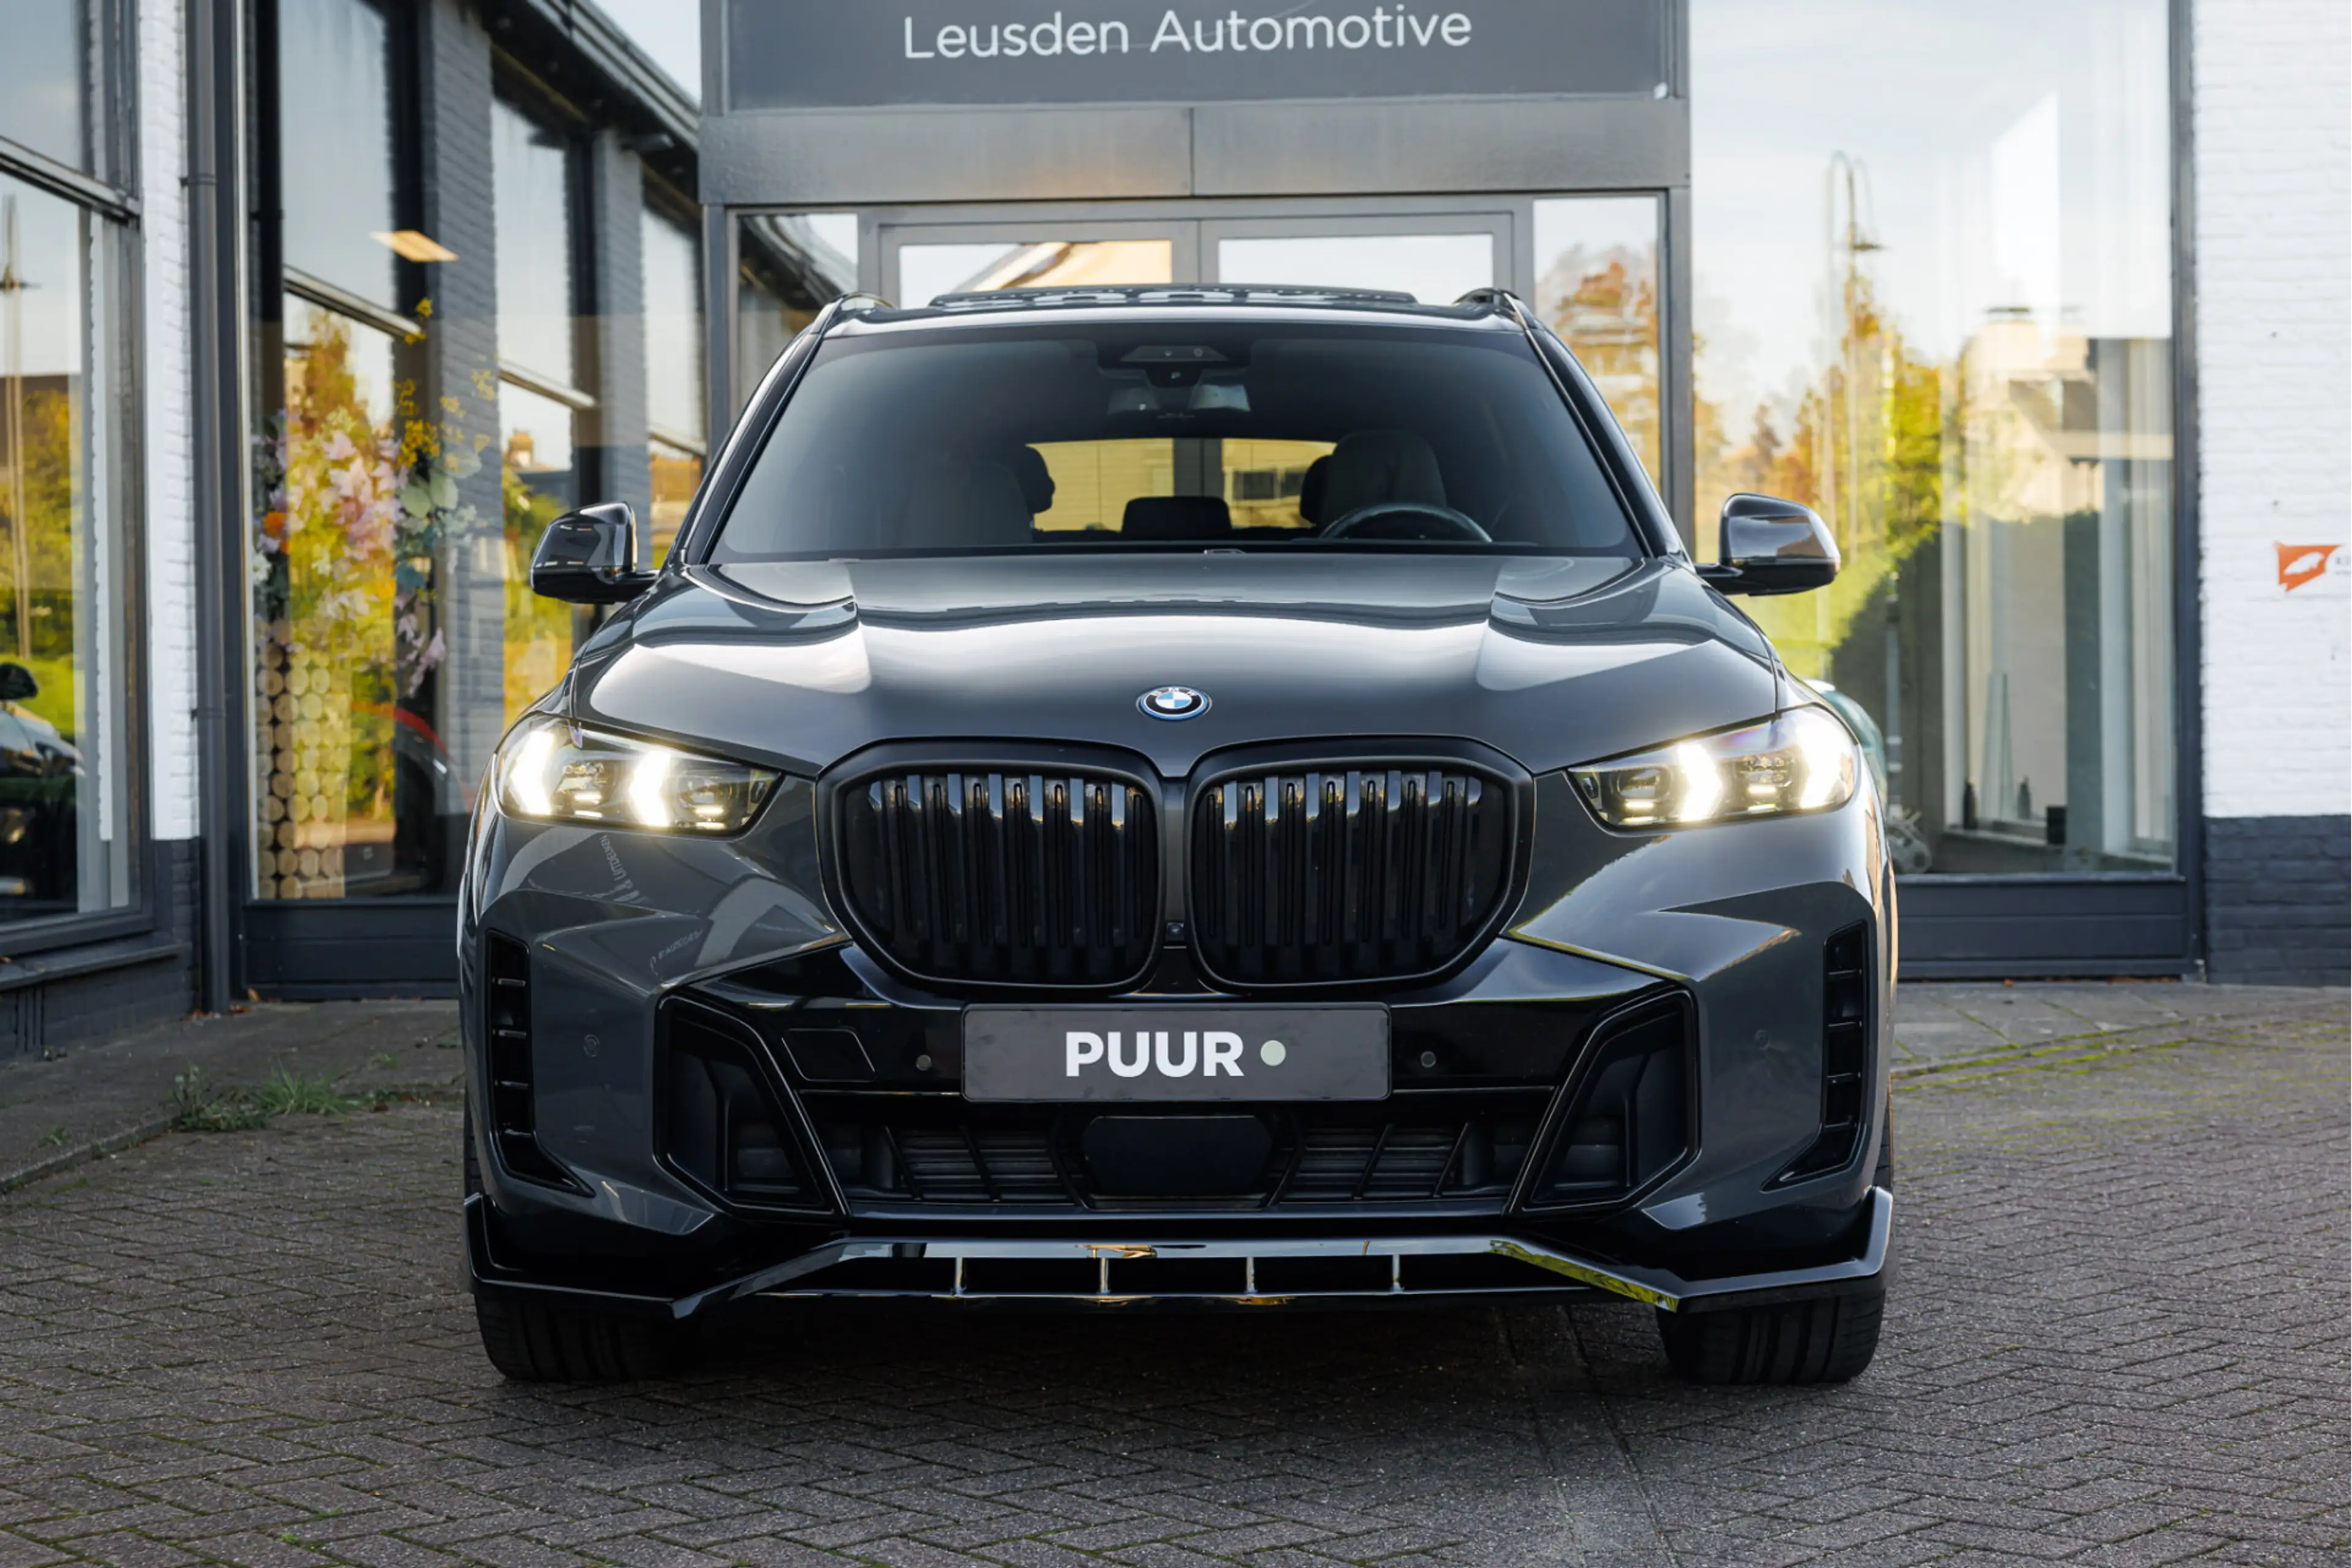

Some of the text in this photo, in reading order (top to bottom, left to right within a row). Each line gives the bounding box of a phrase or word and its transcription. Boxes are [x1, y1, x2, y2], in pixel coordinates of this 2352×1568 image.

[905, 4, 1472, 58] Leusden Automotive
[1066, 1031, 1245, 1077] PUUR
